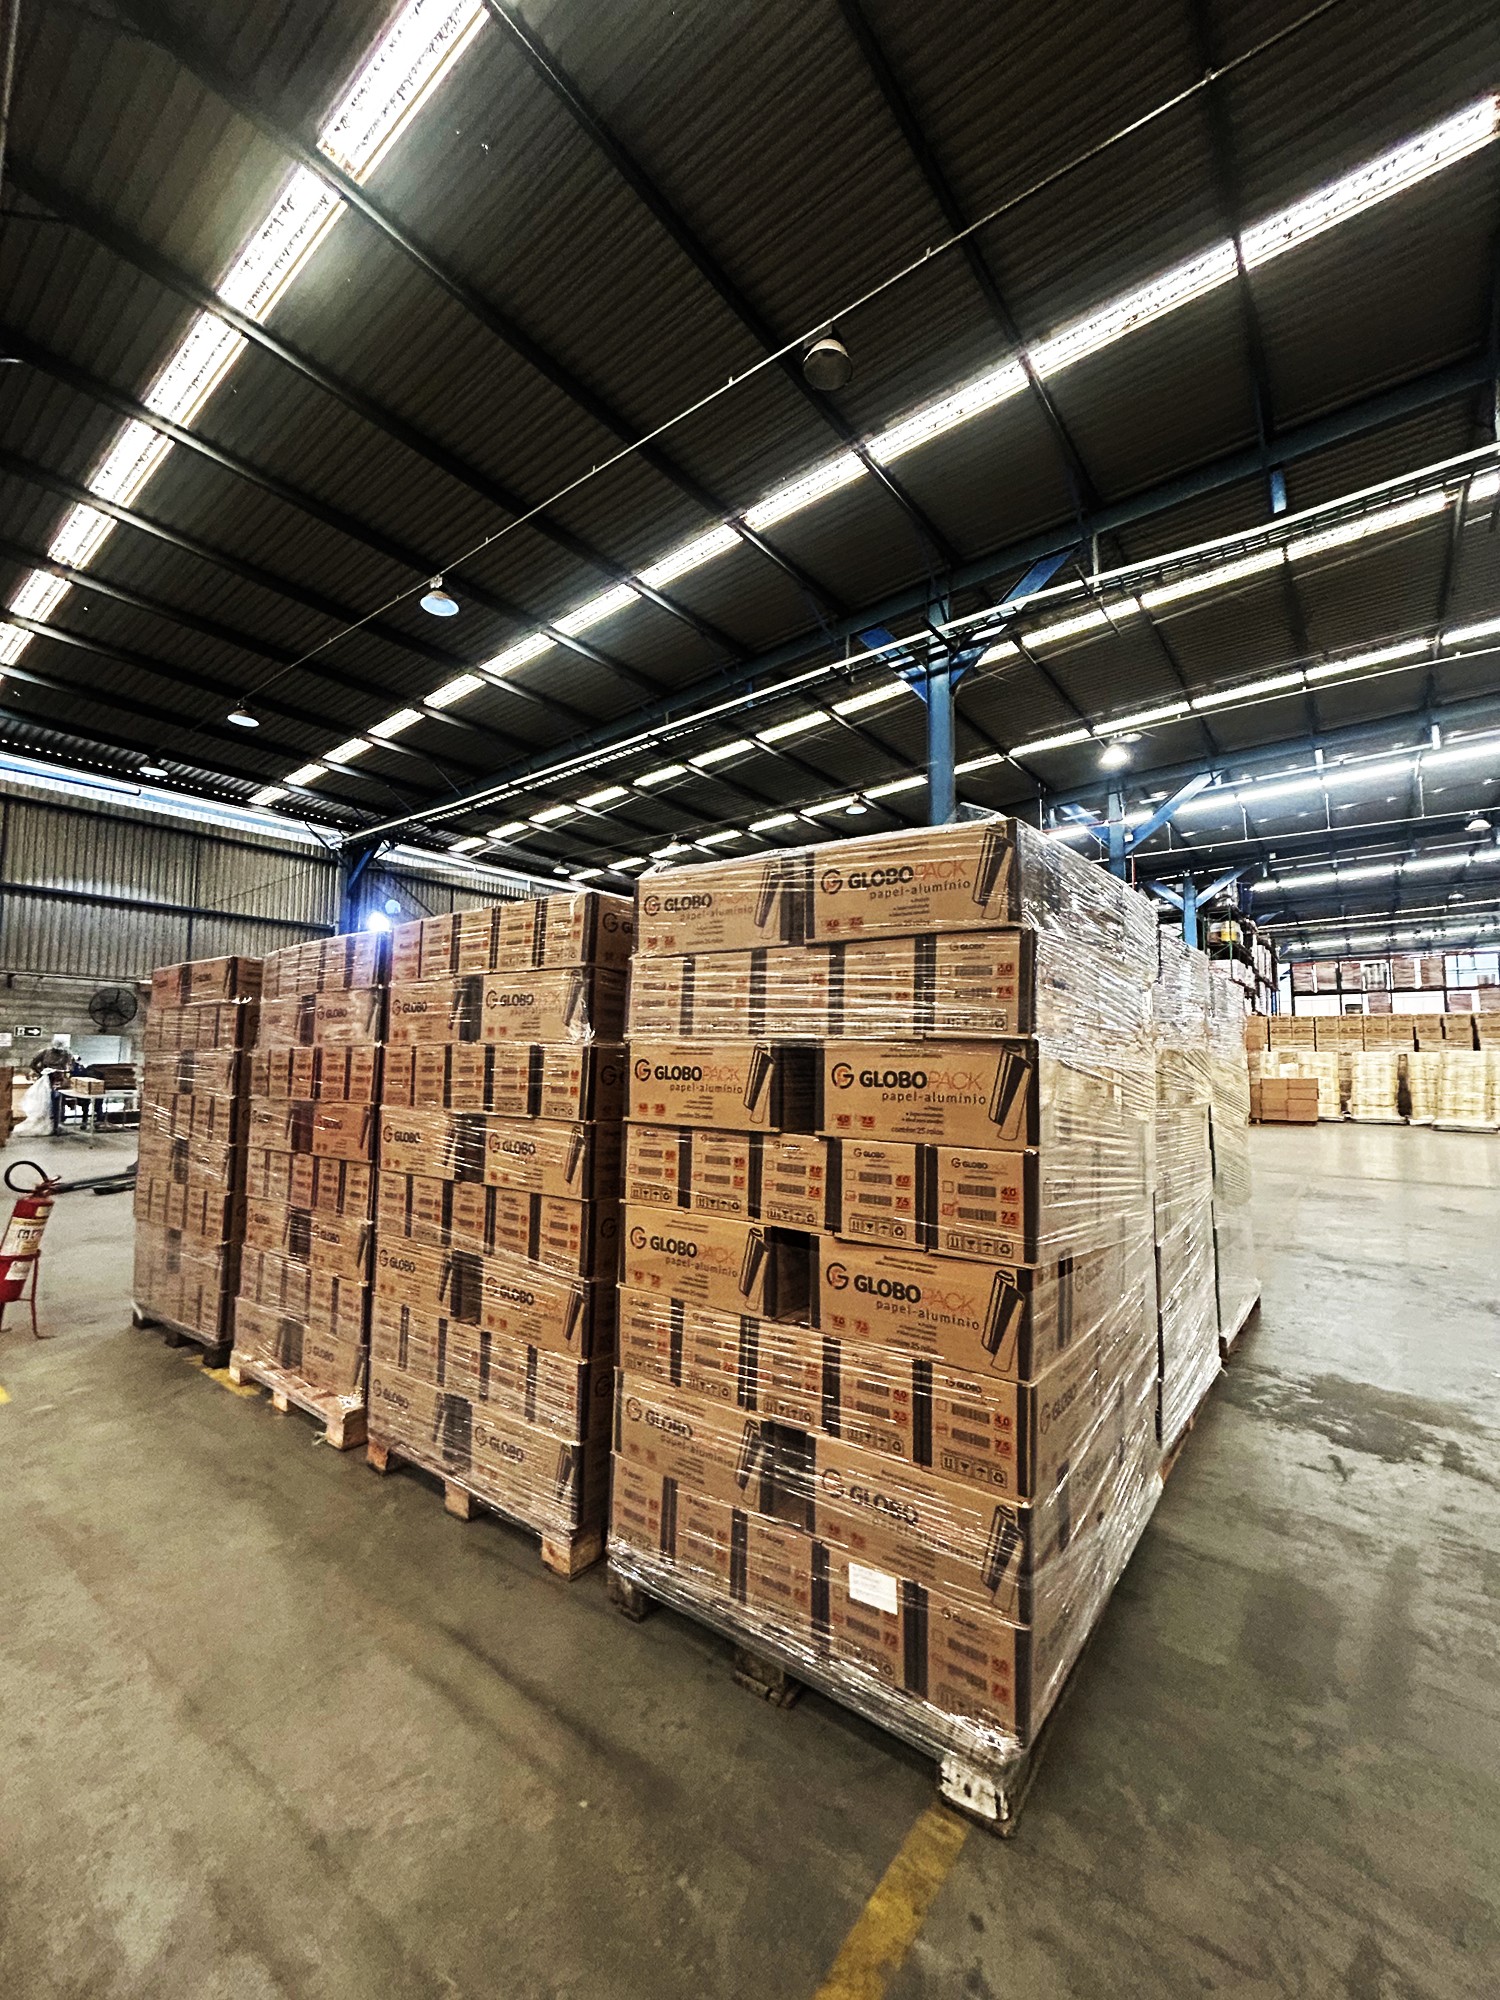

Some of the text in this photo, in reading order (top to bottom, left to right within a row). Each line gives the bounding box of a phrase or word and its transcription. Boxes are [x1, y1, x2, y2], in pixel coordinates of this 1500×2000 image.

[859, 1070, 983, 1092] GLOBOPACK
[881, 1092, 987, 1106] papel-alumínio
[853, 1274, 976, 1319] GLOBOPACK
[875, 1299, 981, 1331] papel-alumínio
